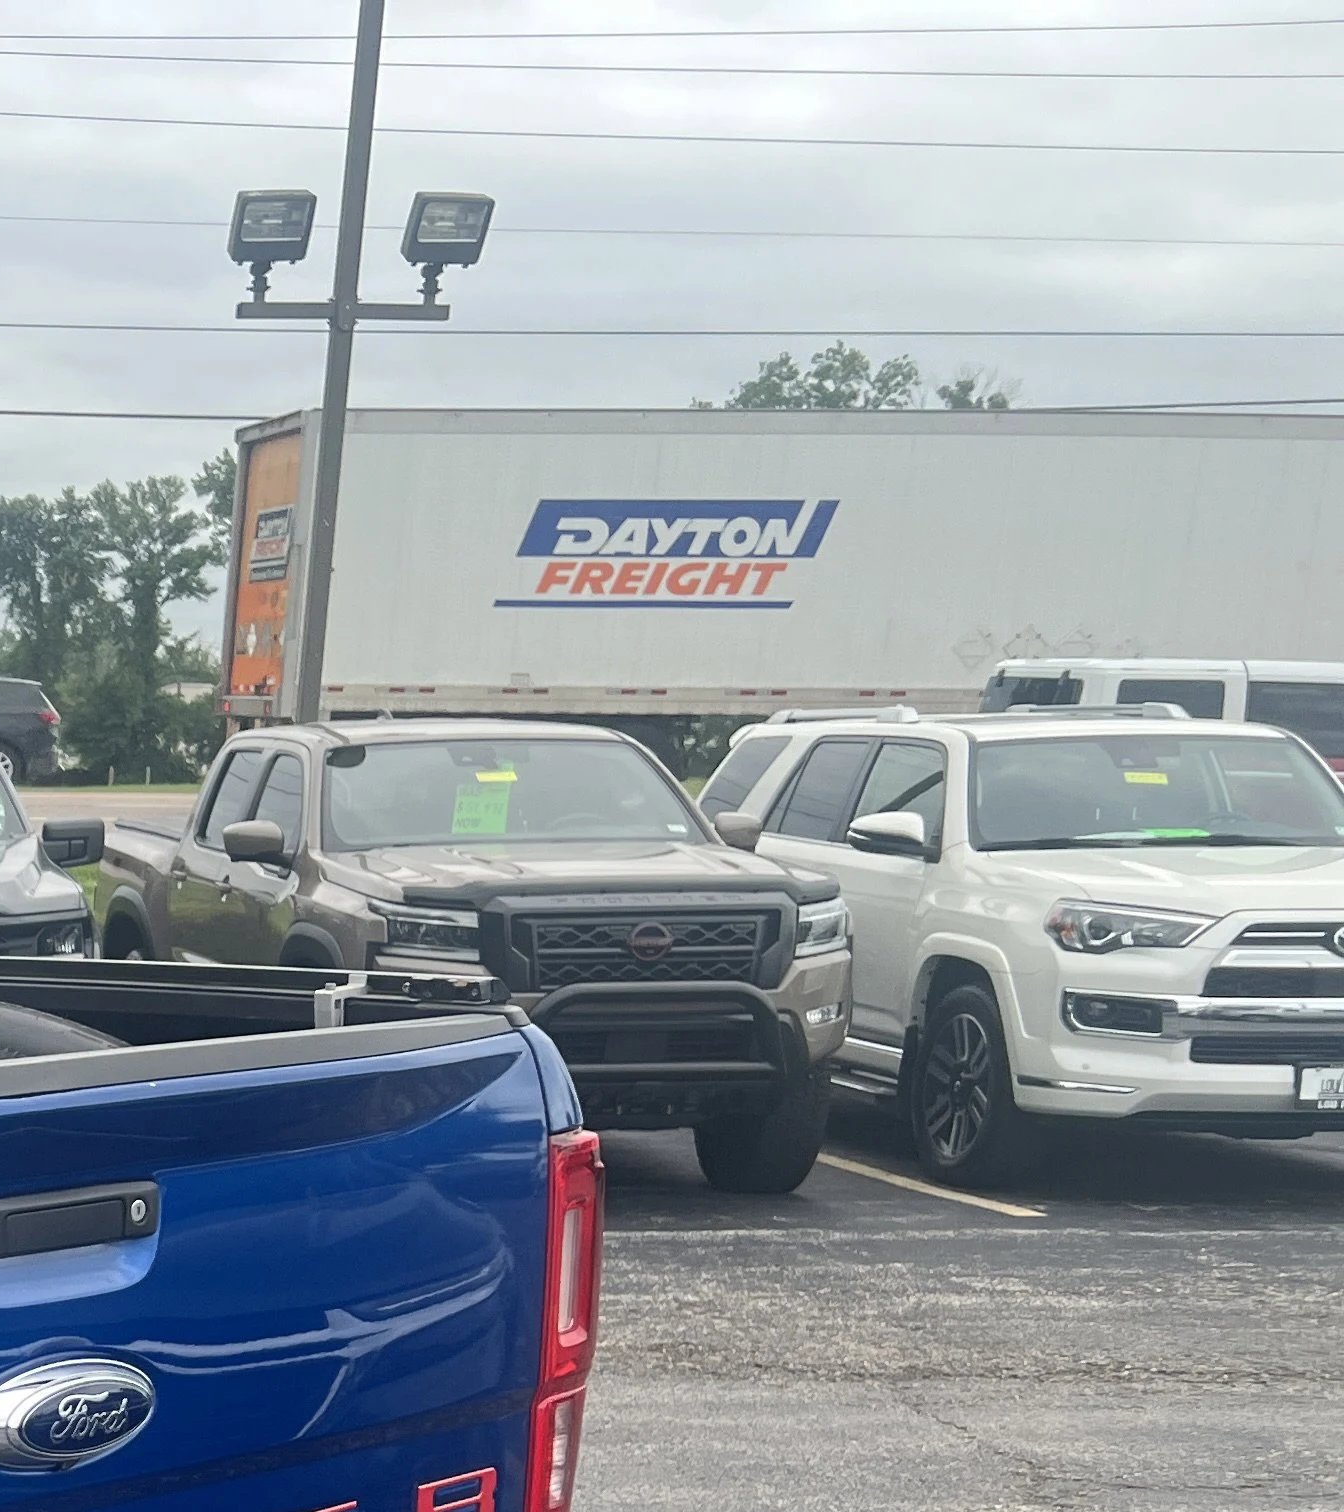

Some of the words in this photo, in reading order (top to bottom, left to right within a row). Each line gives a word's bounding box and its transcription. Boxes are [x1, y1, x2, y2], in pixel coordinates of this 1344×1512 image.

[552, 499, 820, 557] DAYTON
[535, 561, 789, 597] FREIGHT
[50, 1390, 129, 1444] Ford
